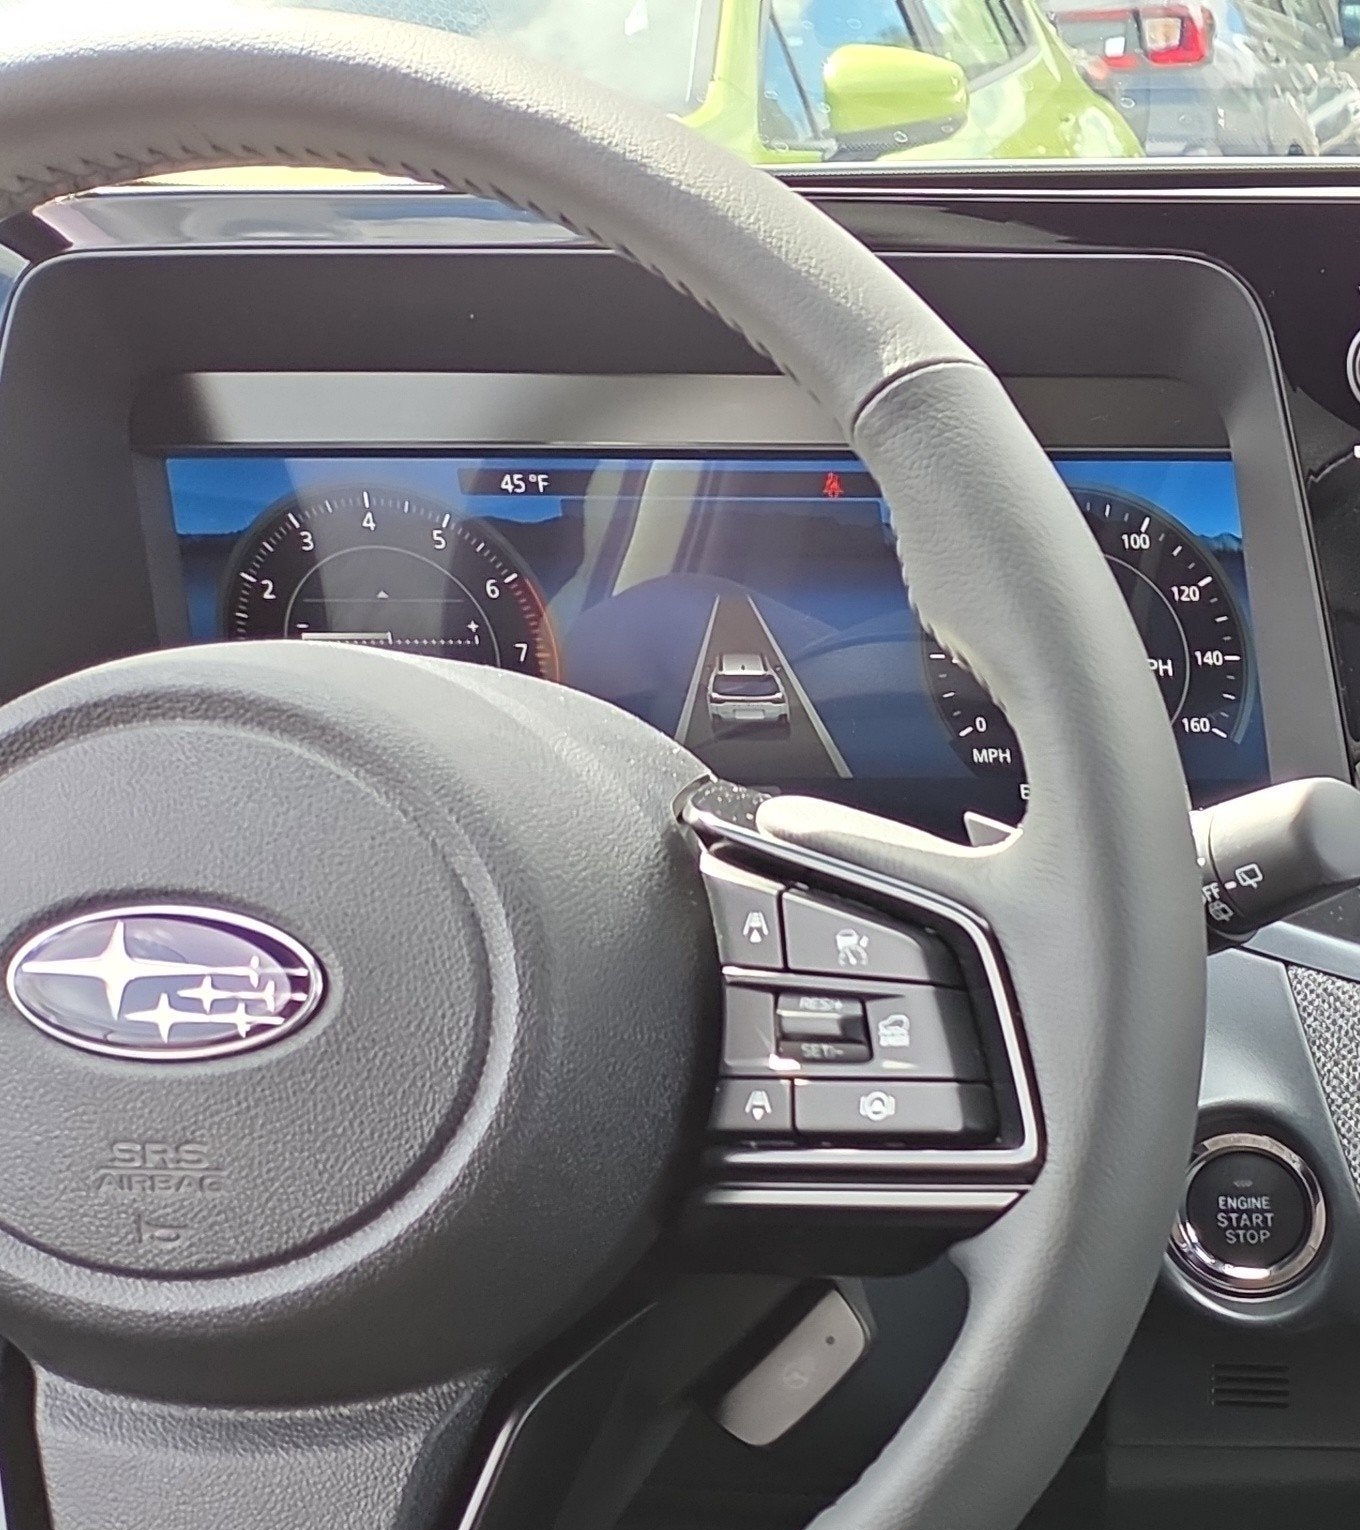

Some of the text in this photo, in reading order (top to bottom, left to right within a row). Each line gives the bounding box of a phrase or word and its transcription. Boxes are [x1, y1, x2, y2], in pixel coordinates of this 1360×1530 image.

[360, 512, 377, 531] 4
[300, 531, 315, 552] 3
[432, 529, 447, 550] 5
[1121, 534, 1151, 550] 100
[261, 579, 277, 600] 2
[485, 579, 500, 599] 6
[1171, 585, 1200, 602] 120
[514, 643, 529, 663] 7
[1194, 650, 1224, 667] 140
[975, 717, 987, 733] 0
[1181, 717, 1211, 734] 160
[972, 748, 1012, 764] MPH
[111, 1140, 210, 1169] SRS
[99, 1174, 225, 1193] AIRBAG
[1217, 1195, 1271, 1210] ENGINE
[1216, 1212, 1275, 1228] START
[1225, 1229, 1271, 1244] STOP
